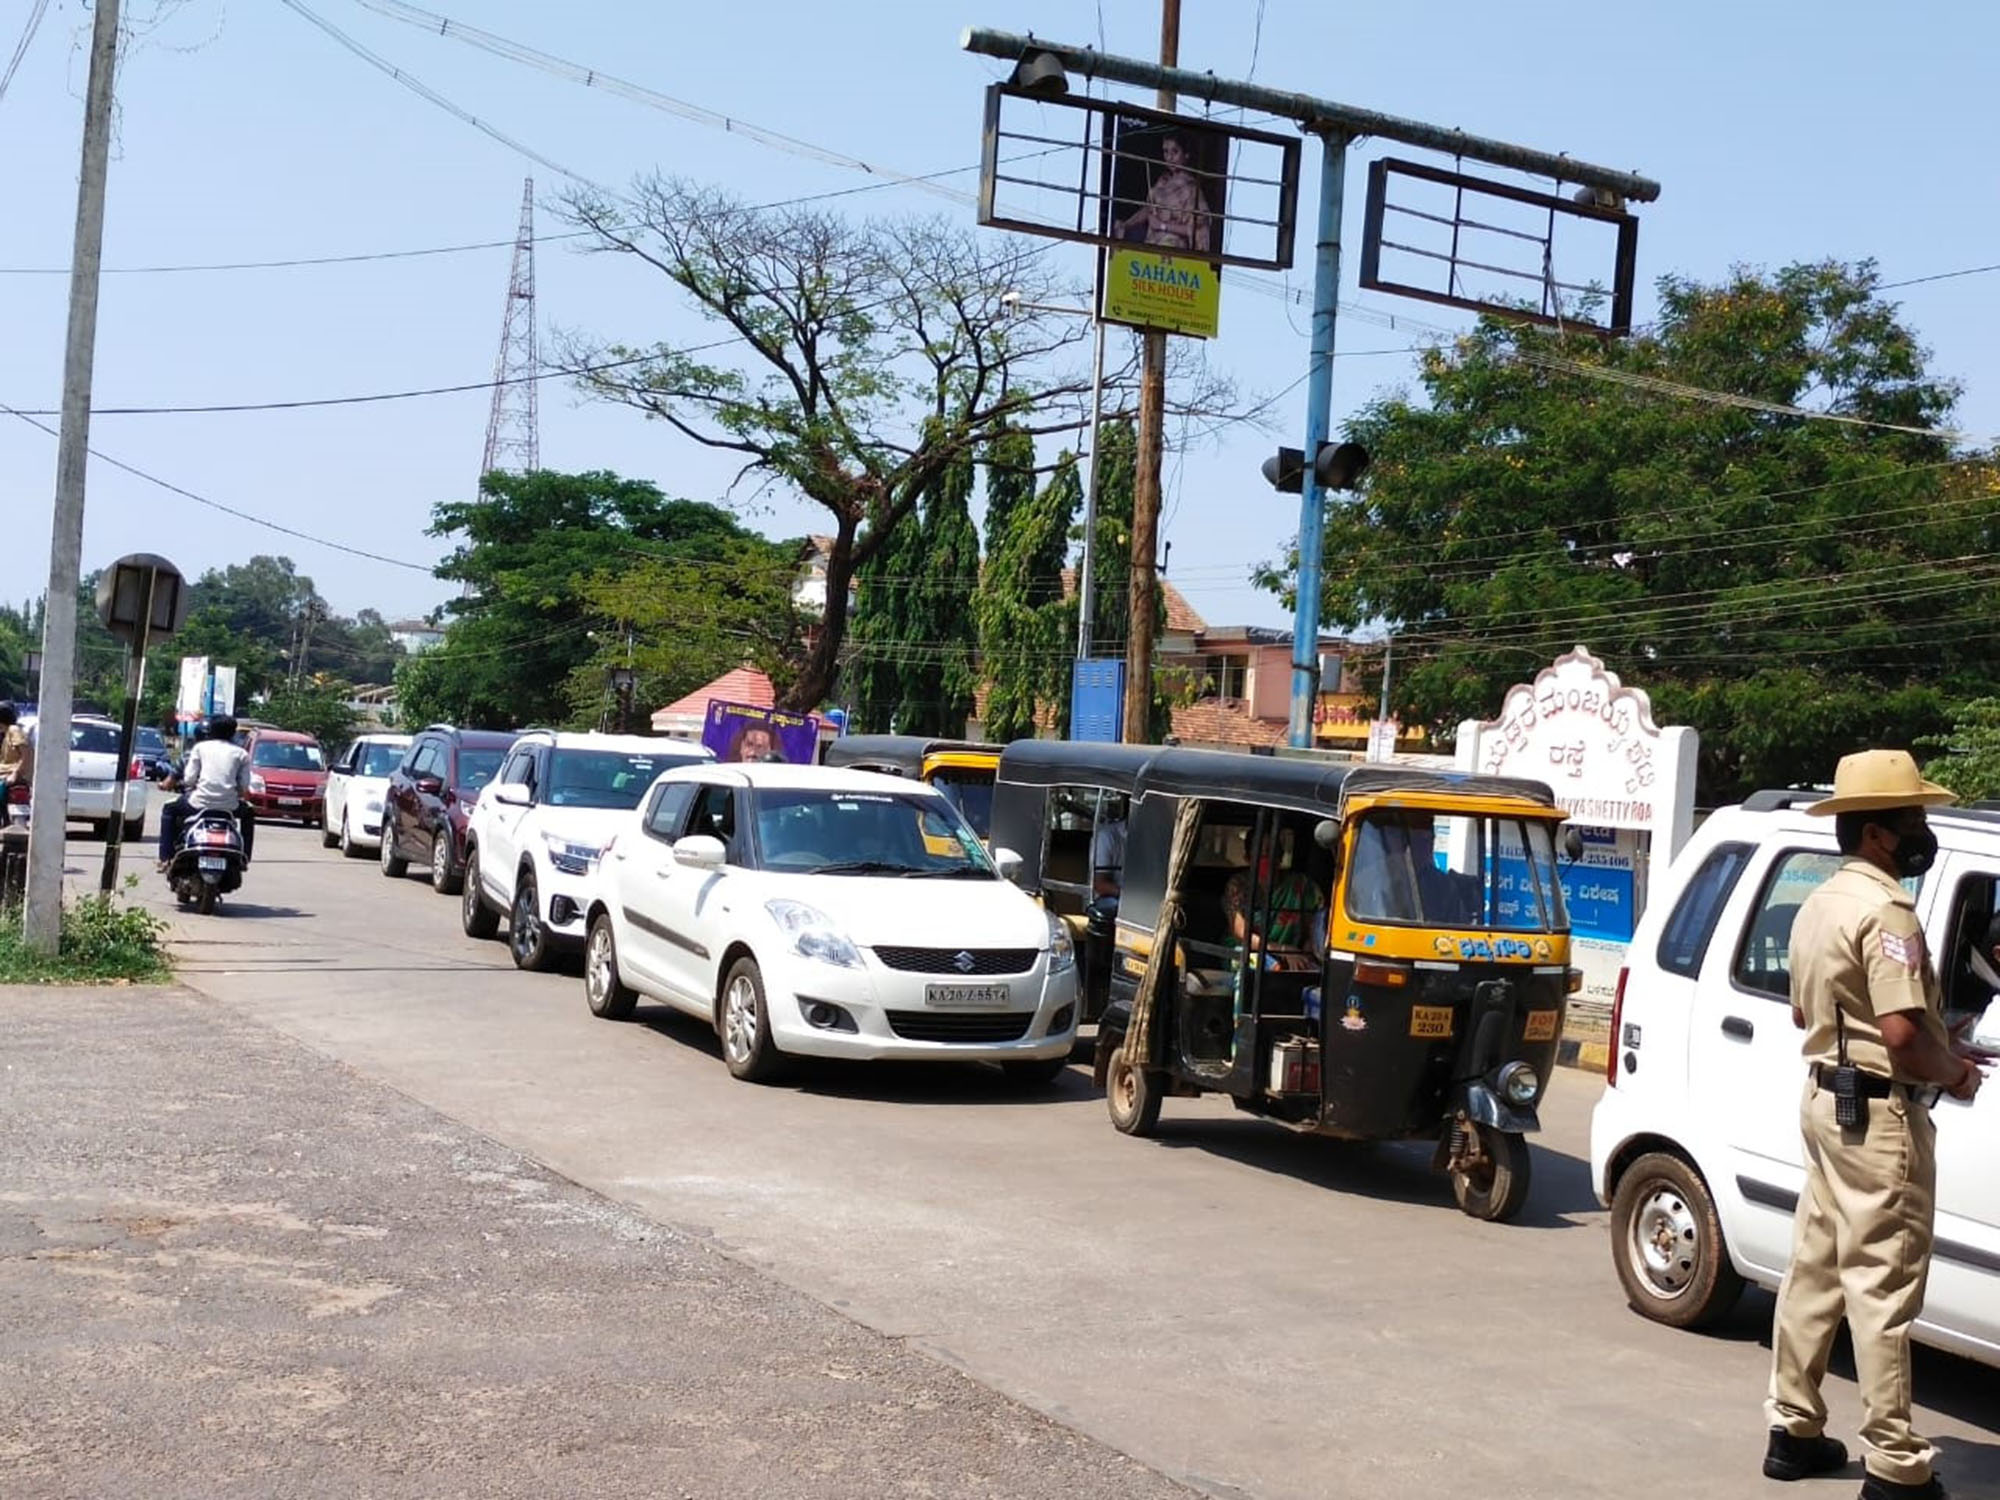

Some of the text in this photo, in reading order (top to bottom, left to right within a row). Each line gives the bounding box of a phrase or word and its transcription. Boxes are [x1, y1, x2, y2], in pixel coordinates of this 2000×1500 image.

[1130, 261, 1201, 290] SAHANA
[1132, 279, 1155, 295] SILK
[1159, 285, 1197, 301] HOUSE
[1549, 740, 1586, 778] ರಸ್ತೆ
[1417, 1022, 1444, 1033] 230
